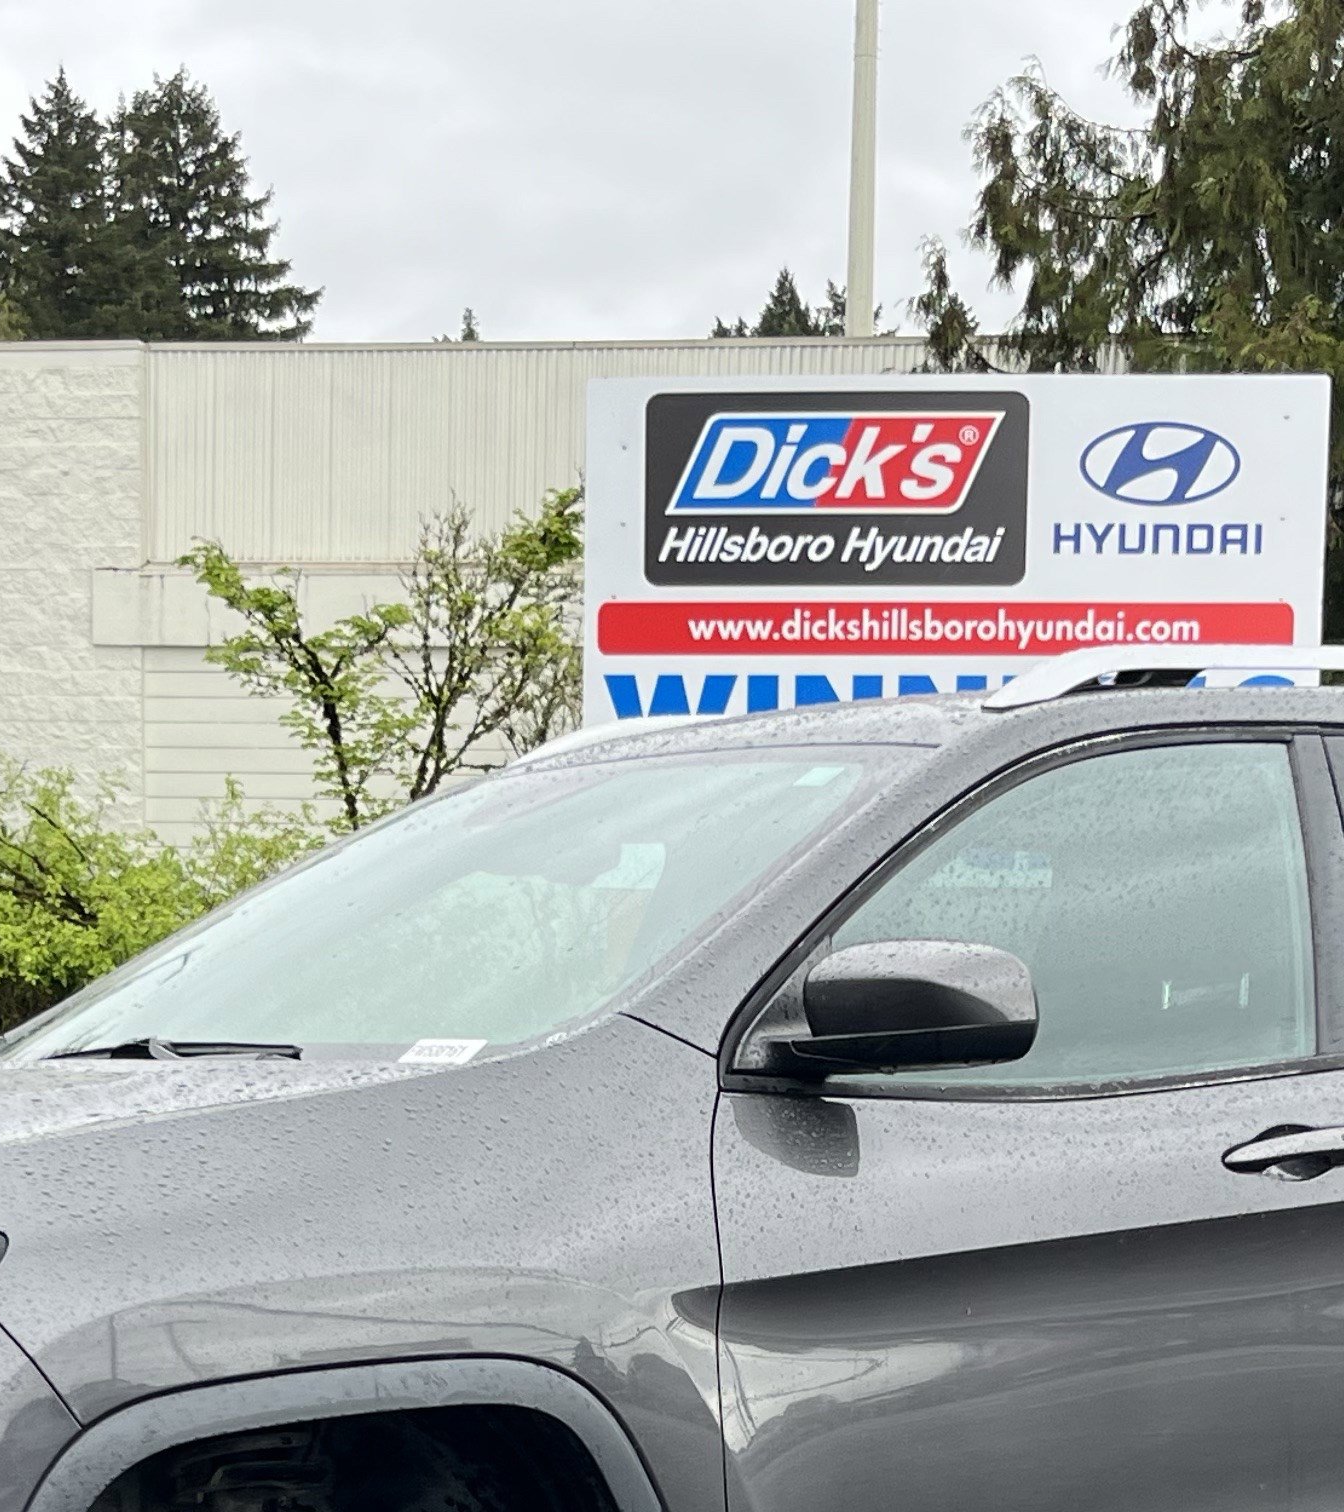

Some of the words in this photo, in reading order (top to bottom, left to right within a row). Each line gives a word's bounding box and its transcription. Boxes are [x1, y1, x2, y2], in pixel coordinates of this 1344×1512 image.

[692, 423, 963, 500] Dick's
[658, 526, 835, 563] Hillsboro
[840, 526, 1006, 572] Hyundai
[1053, 522, 1264, 555] HYUNDAI
[688, 607, 1200, 647] www.dickshillsborohyundai.com
